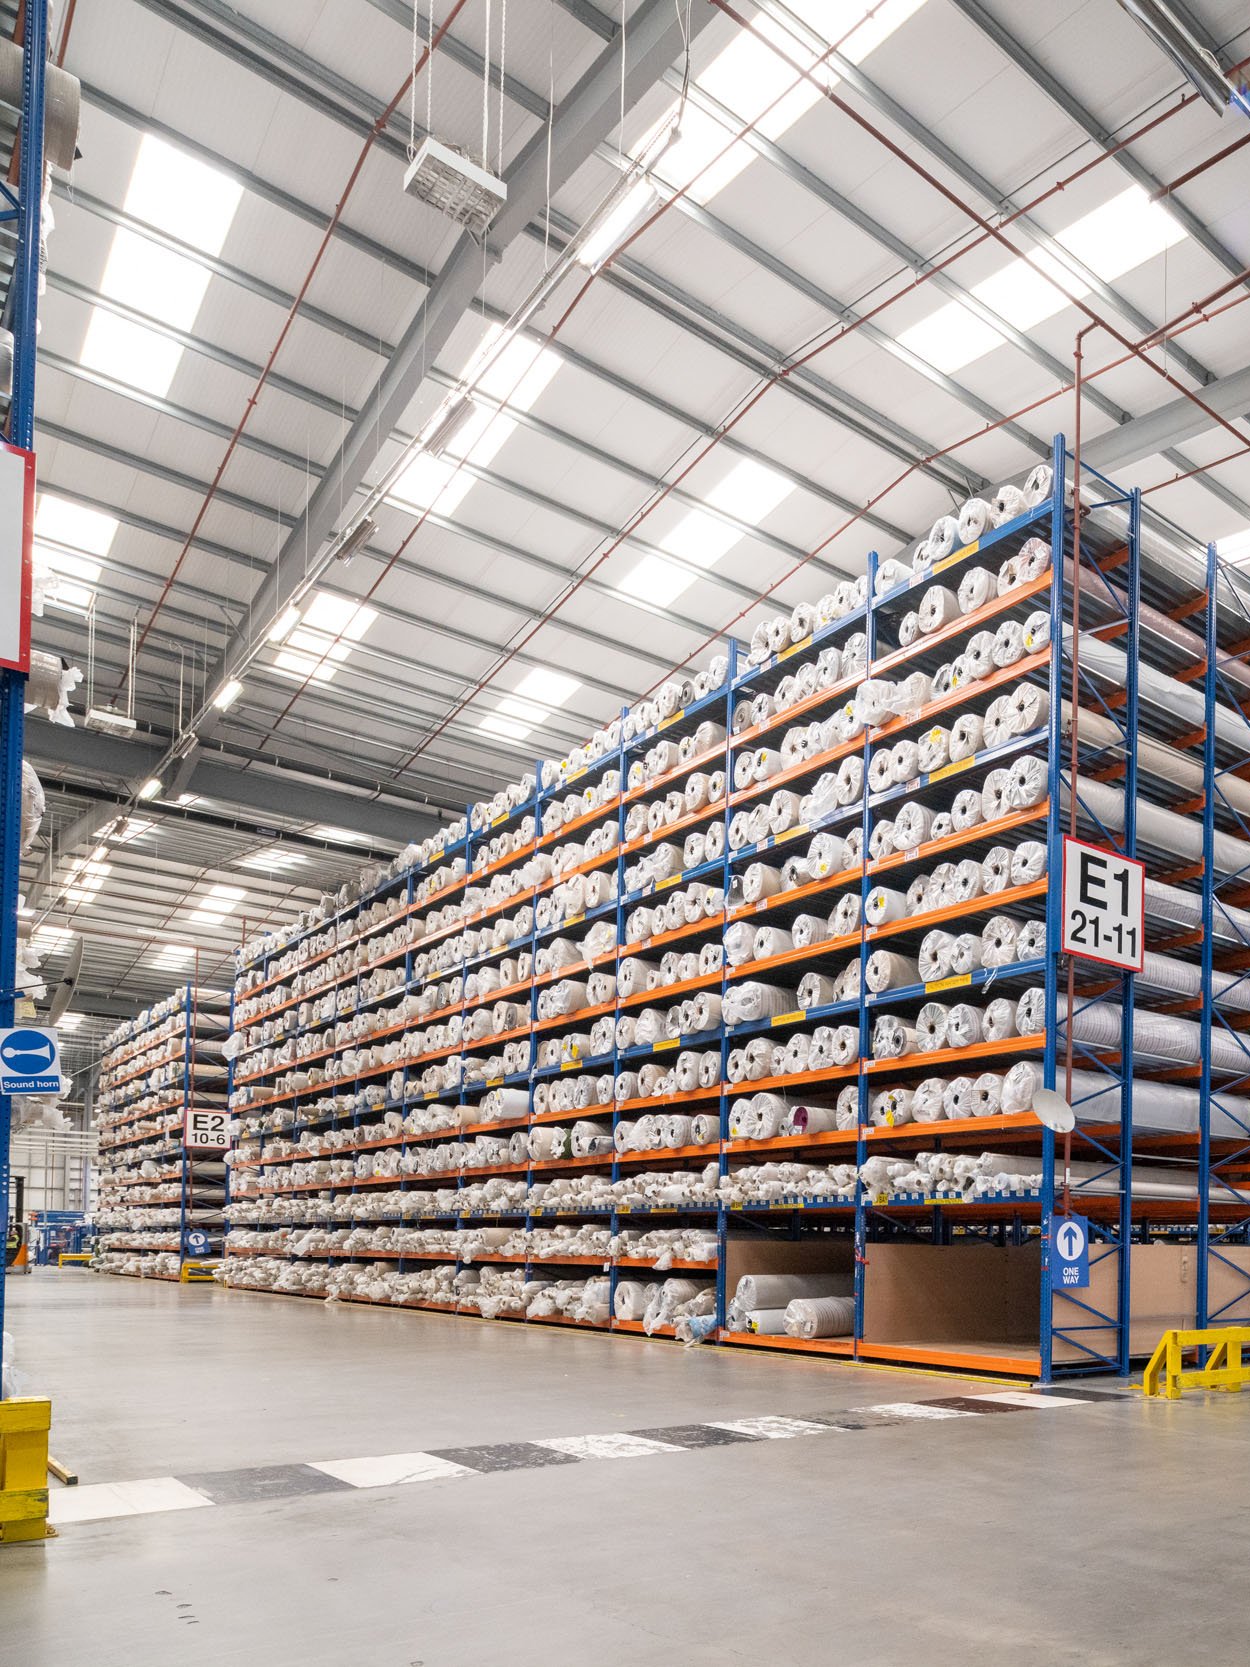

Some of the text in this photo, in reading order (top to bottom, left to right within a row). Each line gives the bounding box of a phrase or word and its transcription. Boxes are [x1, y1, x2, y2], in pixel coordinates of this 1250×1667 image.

[1079, 851, 1129, 917] E1
[1070, 909, 1136, 958] 21-11
[3, 1080, 59, 1089] Sound horn
[193, 1113, 225, 1132] E2
[191, 1132, 226, 1145] 10-6
[1062, 1267, 1080, 1276] ONE
[1062, 1275, 1080, 1285] WAY
